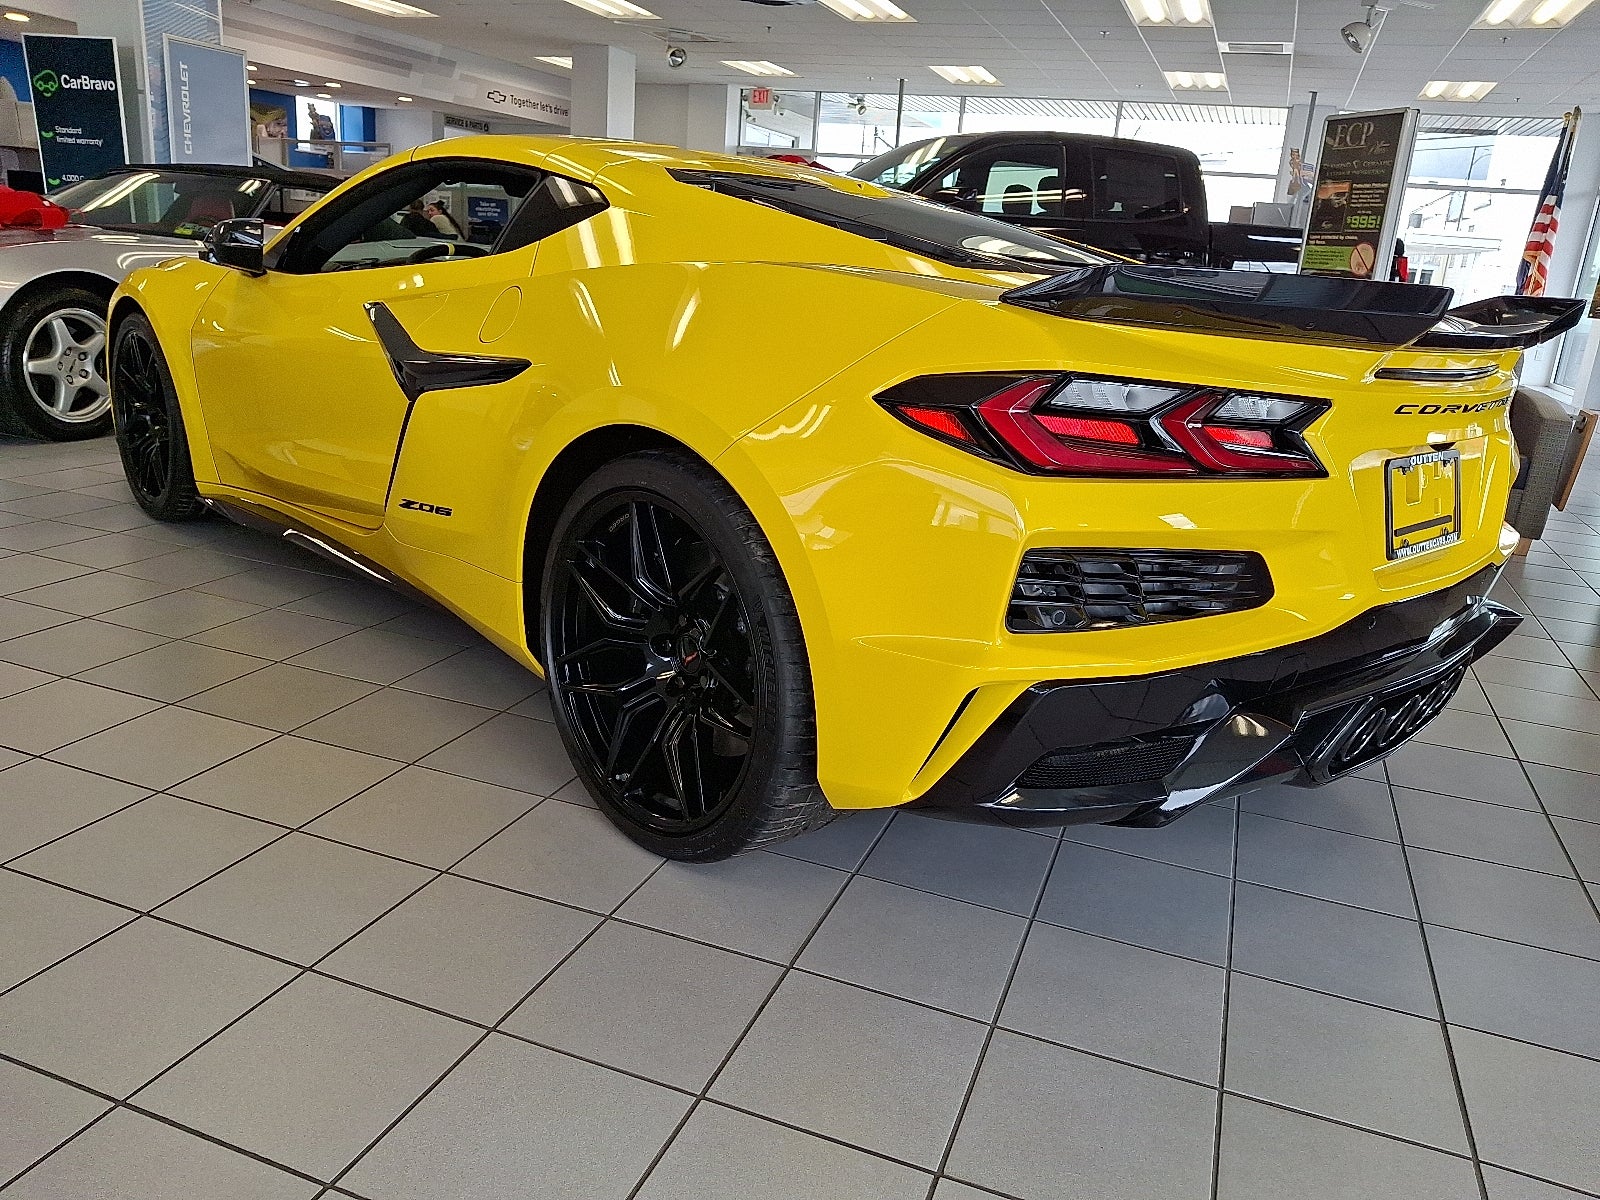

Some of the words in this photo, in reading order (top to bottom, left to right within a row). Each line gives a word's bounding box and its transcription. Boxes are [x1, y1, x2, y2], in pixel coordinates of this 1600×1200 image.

[60, 74, 116, 91] CarBravo
[752, 88, 770, 104] EXIT
[179, 60, 193, 155] CHEVROLET
[510, 94, 539, 109] Together
[540, 101, 553, 113] let's
[553, 104, 569, 117] drive
[54, 125, 82, 135] Standard
[56, 135, 76, 144] limited
[1346, 215, 1381, 229] $995!
[1409, 450, 1444, 466] OUTTEN
[398, 498, 453, 517] Z06
